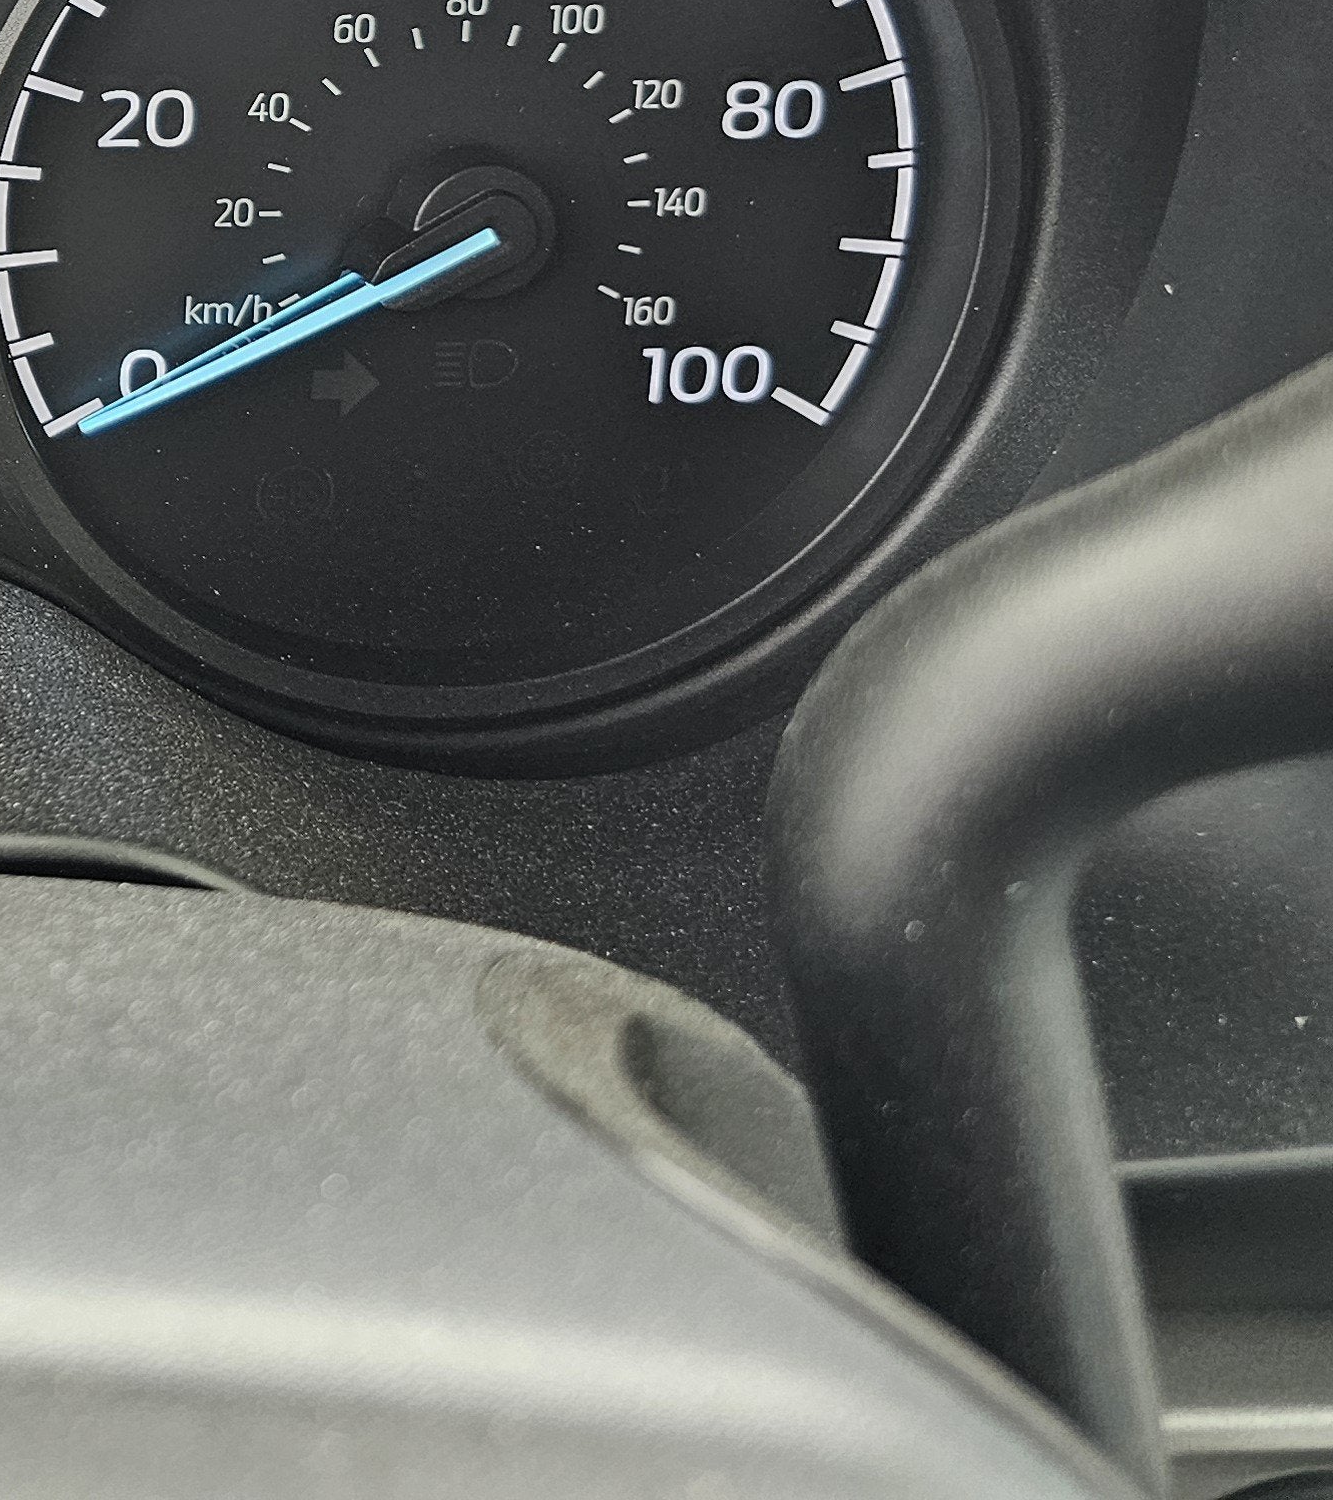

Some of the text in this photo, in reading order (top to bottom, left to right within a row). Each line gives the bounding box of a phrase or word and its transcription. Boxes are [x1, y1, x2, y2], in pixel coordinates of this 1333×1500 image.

[333, 13, 376, 44] 60
[549, 3, 605, 35] 100
[247, 92, 290, 122] 40
[632, 78, 682, 110] 120
[721, 79, 824, 140] 80
[97, 89, 194, 148] 20
[214, 197, 254, 228] 20
[654, 187, 706, 217] 140
[183, 293, 273, 327] km/h
[623, 296, 675, 326] 160
[118, 348, 168, 398] 0
[642, 345, 772, 404] 100
